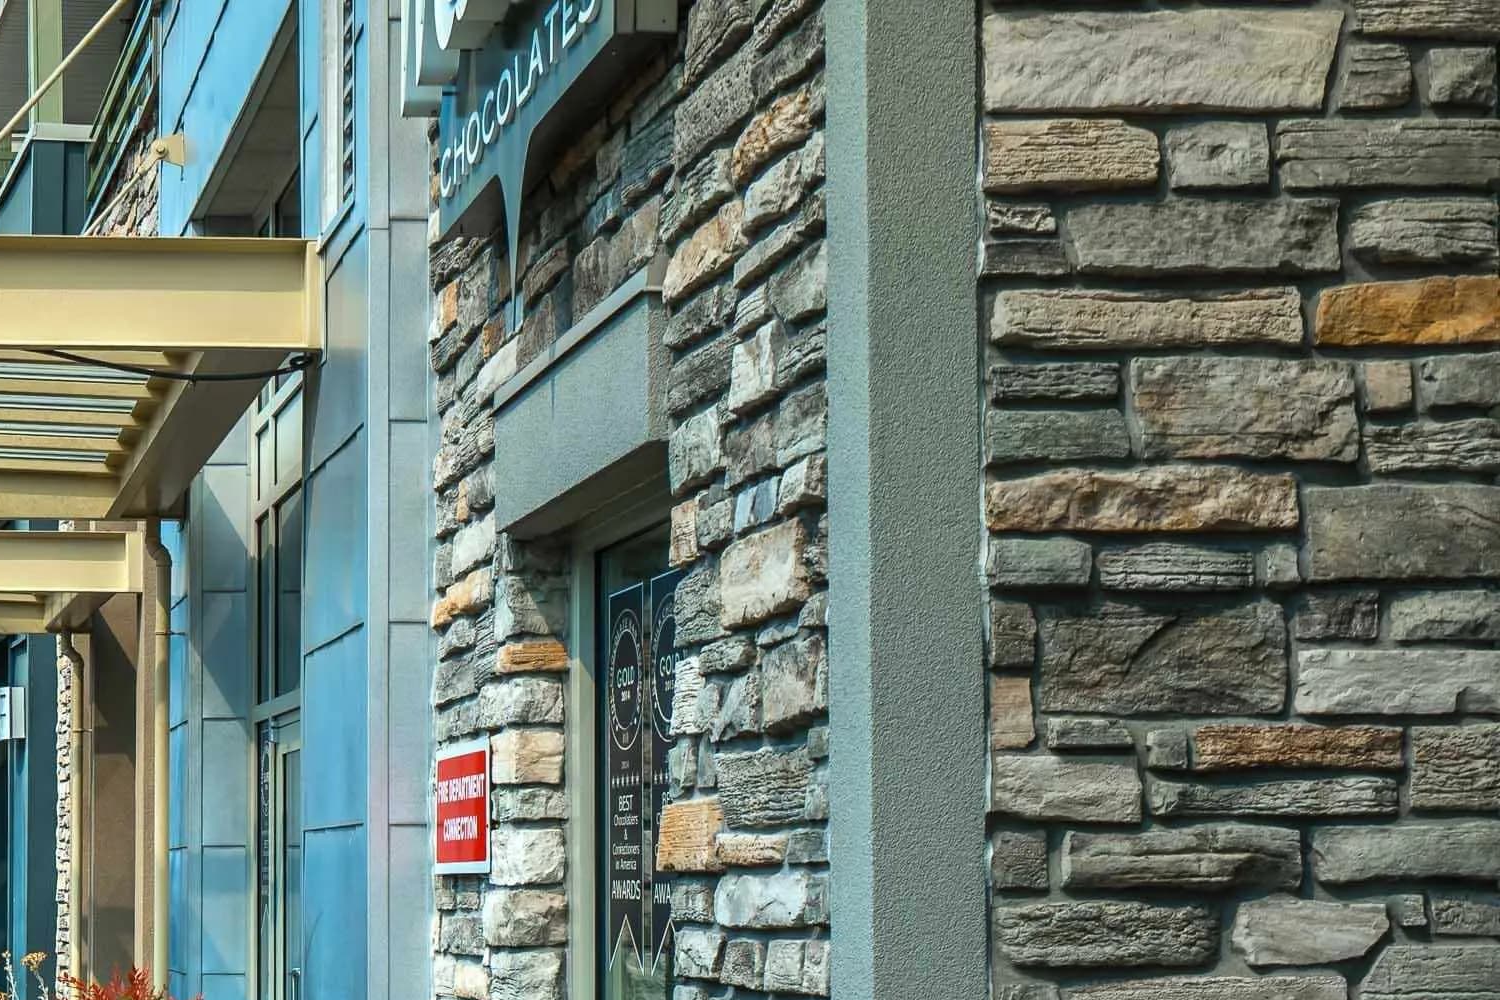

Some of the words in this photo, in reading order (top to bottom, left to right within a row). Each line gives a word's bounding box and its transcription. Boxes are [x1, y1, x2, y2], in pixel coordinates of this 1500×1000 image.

[616, 665, 635, 689] GOLD
[438, 780, 448, 804] FIRE
[449, 773, 484, 802] DEPARTMENT
[618, 794, 634, 812] BEST
[443, 815, 478, 842] CONNECTION
[623, 829, 628, 841] &
[612, 843, 640, 856] Confectioners
[611, 879, 641, 900] AWARDS
[653, 883, 671, 905] AWA
